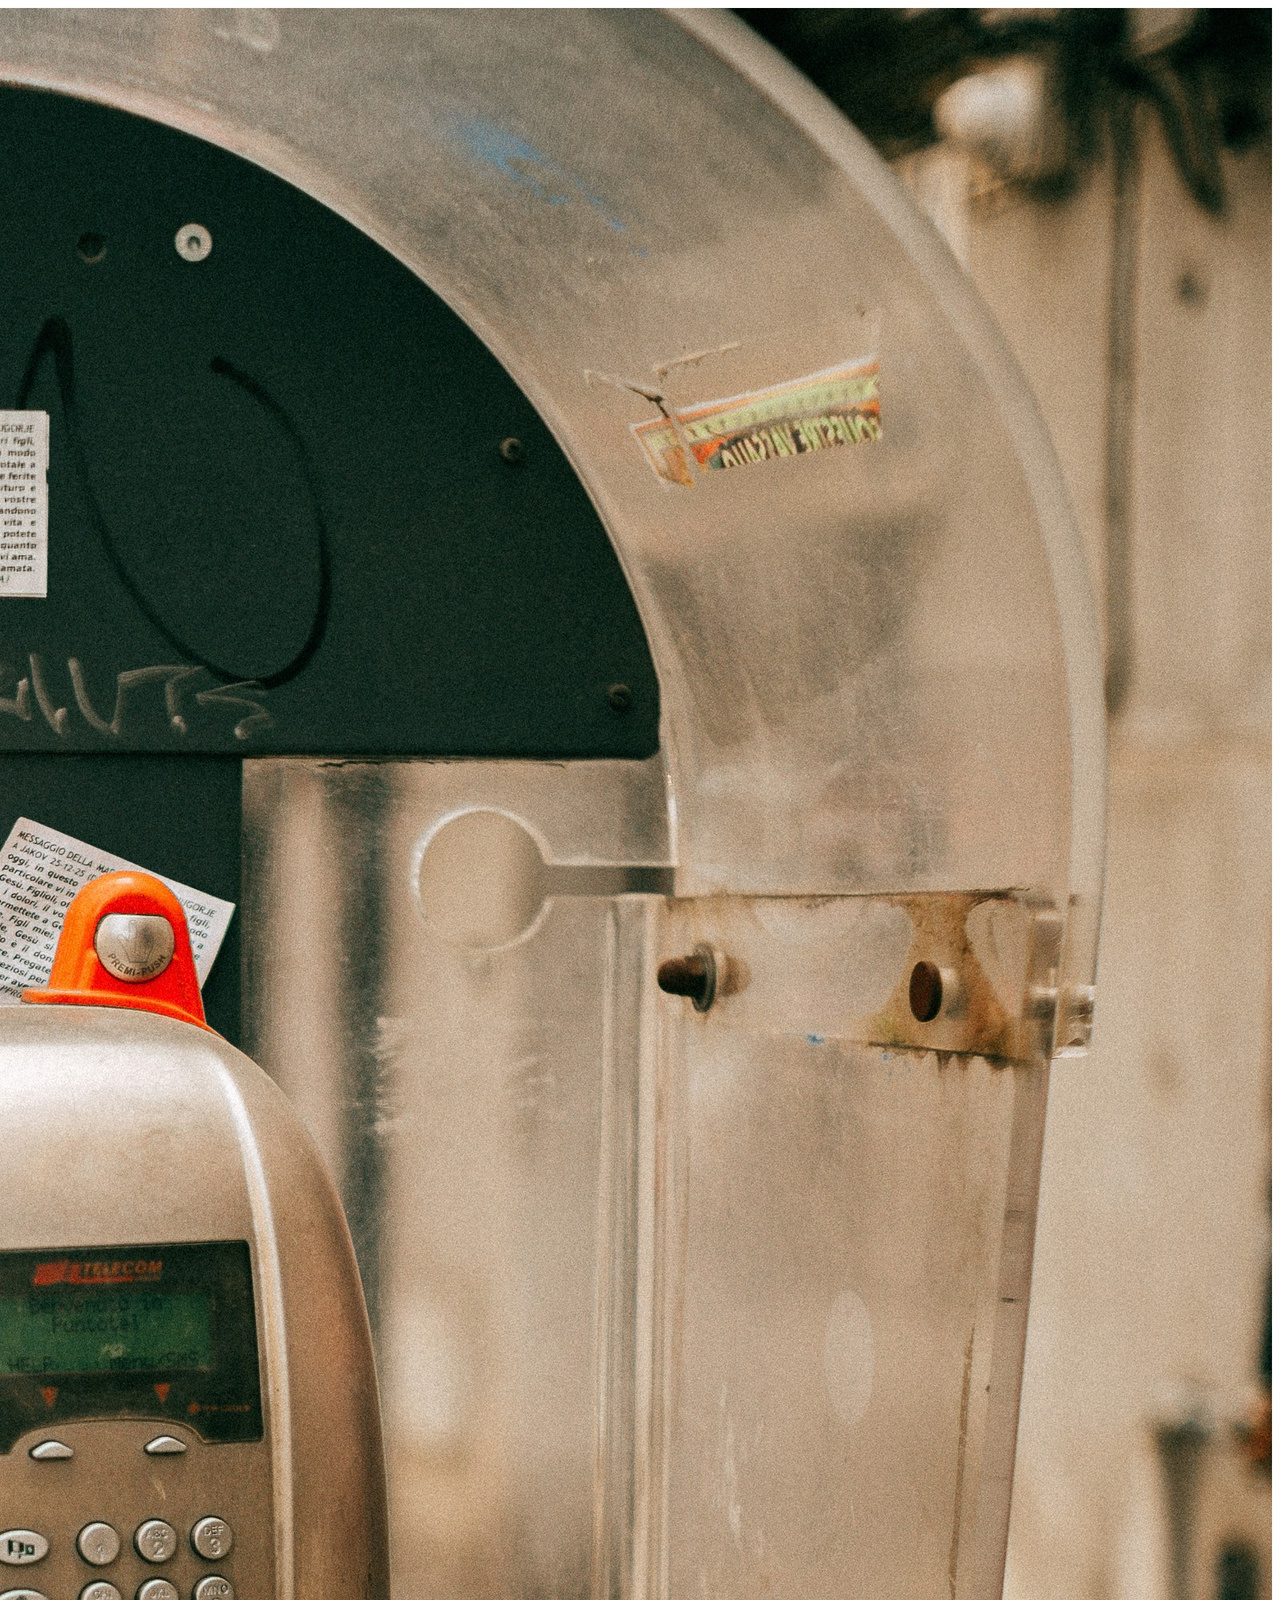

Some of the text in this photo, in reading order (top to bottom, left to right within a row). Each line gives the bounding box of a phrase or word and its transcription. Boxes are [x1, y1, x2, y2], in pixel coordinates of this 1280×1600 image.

[18, 832, 94, 868] MESSAGGIO DELLA
[8, 854, 79, 888] oggi, in questo
[20, 846, 49, 861] JAKOV
[50, 858, 87, 878] 25-12-25
[2, 865, 54, 890] particolare
[0, 874, 58, 905] Gesù. Figlioli,
[9, 916, 30, 928] Figli
[32, 927, 55, 940] miei,
[190, 915, 210, 930] figli,
[15, 930, 39, 945] Gesù
[44, 944, 55, 952] si
[13, 954, 52, 974] Pregate
[107, 953, 167, 977] PREMI-PUSH
[28, 975, 47, 985] per
[81, 1260, 163, 1277] TELECOM
[203, 1525, 224, 1537] DEF
[152, 1541, 167, 1559] 2
[209, 1537, 222, 1556] 3
[203, 1584, 229, 1597] MNO
